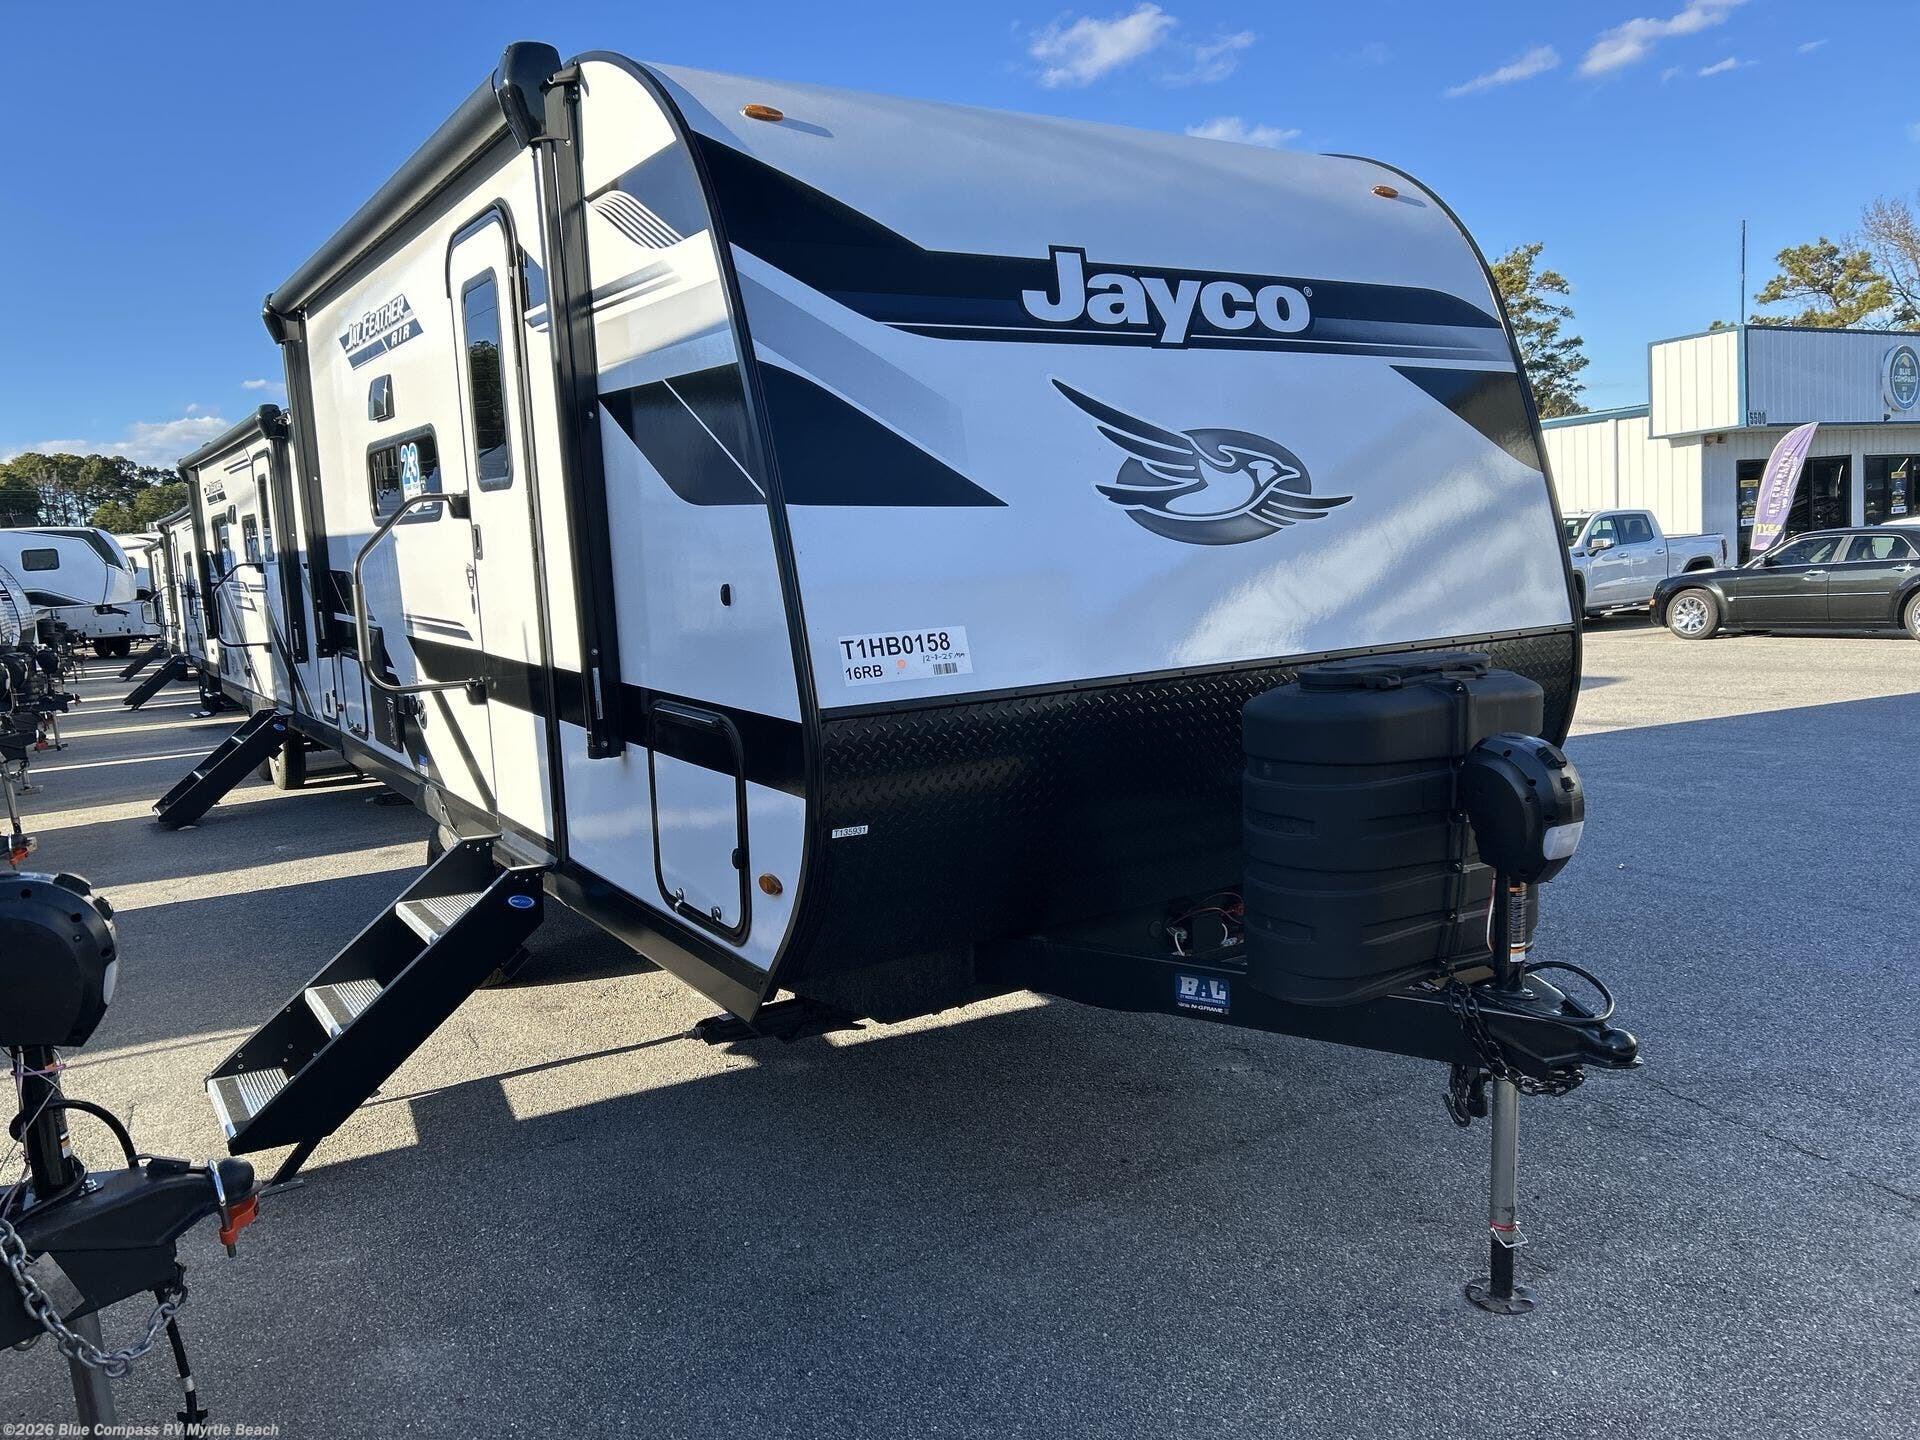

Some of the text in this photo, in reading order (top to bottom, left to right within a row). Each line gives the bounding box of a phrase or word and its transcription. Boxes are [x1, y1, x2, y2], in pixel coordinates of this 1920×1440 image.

[1022, 251, 1310, 343] Jayco
[361, 295, 405, 341] FEATHER
[390, 323, 410, 347] AIR
[1749, 411, 1766, 425] 5500
[401, 443, 419, 485] 23
[840, 632, 950, 660] T1HB0158
[845, 664, 883, 680] 16RB
